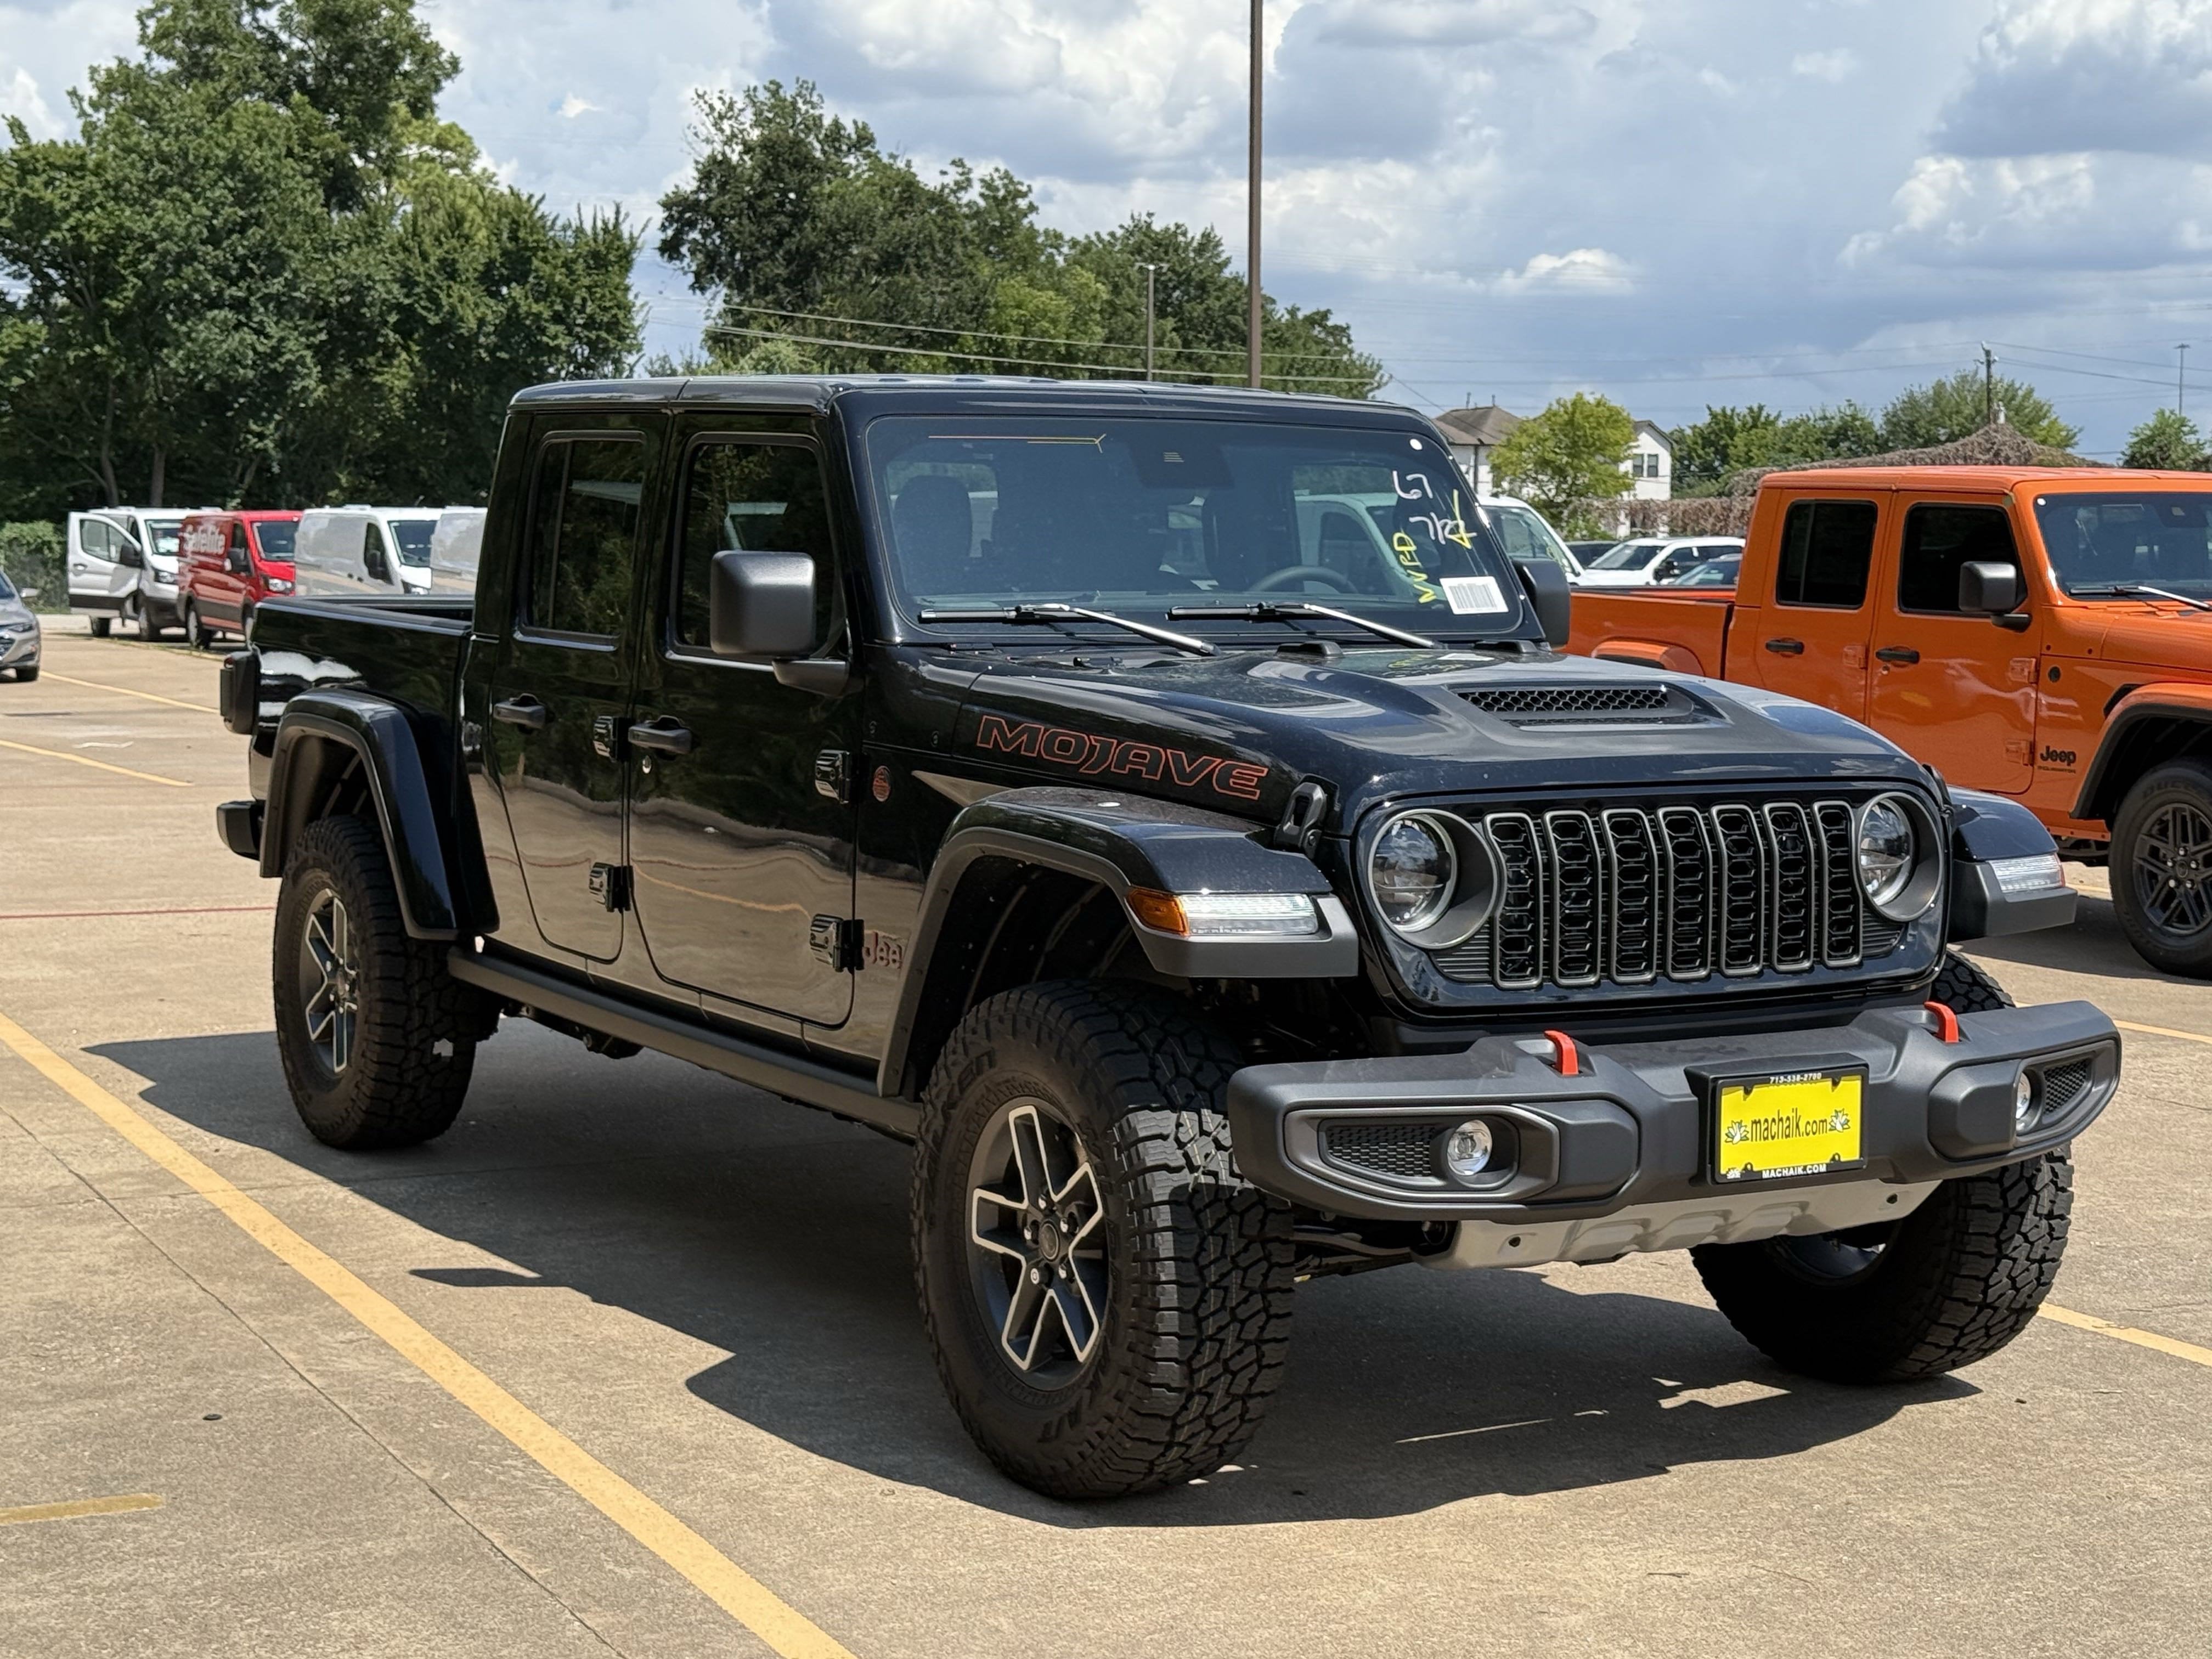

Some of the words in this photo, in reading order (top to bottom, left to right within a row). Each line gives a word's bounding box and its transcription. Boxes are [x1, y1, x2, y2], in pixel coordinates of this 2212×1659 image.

[976, 715, 1269, 801] MOJAVE
[2039, 744, 2077, 765] Jeep
[863, 930, 904, 970] Jee
[1751, 1107, 1827, 1142] machaik.com
[1762, 1163, 1827, 1179] MACHAIK.COM
